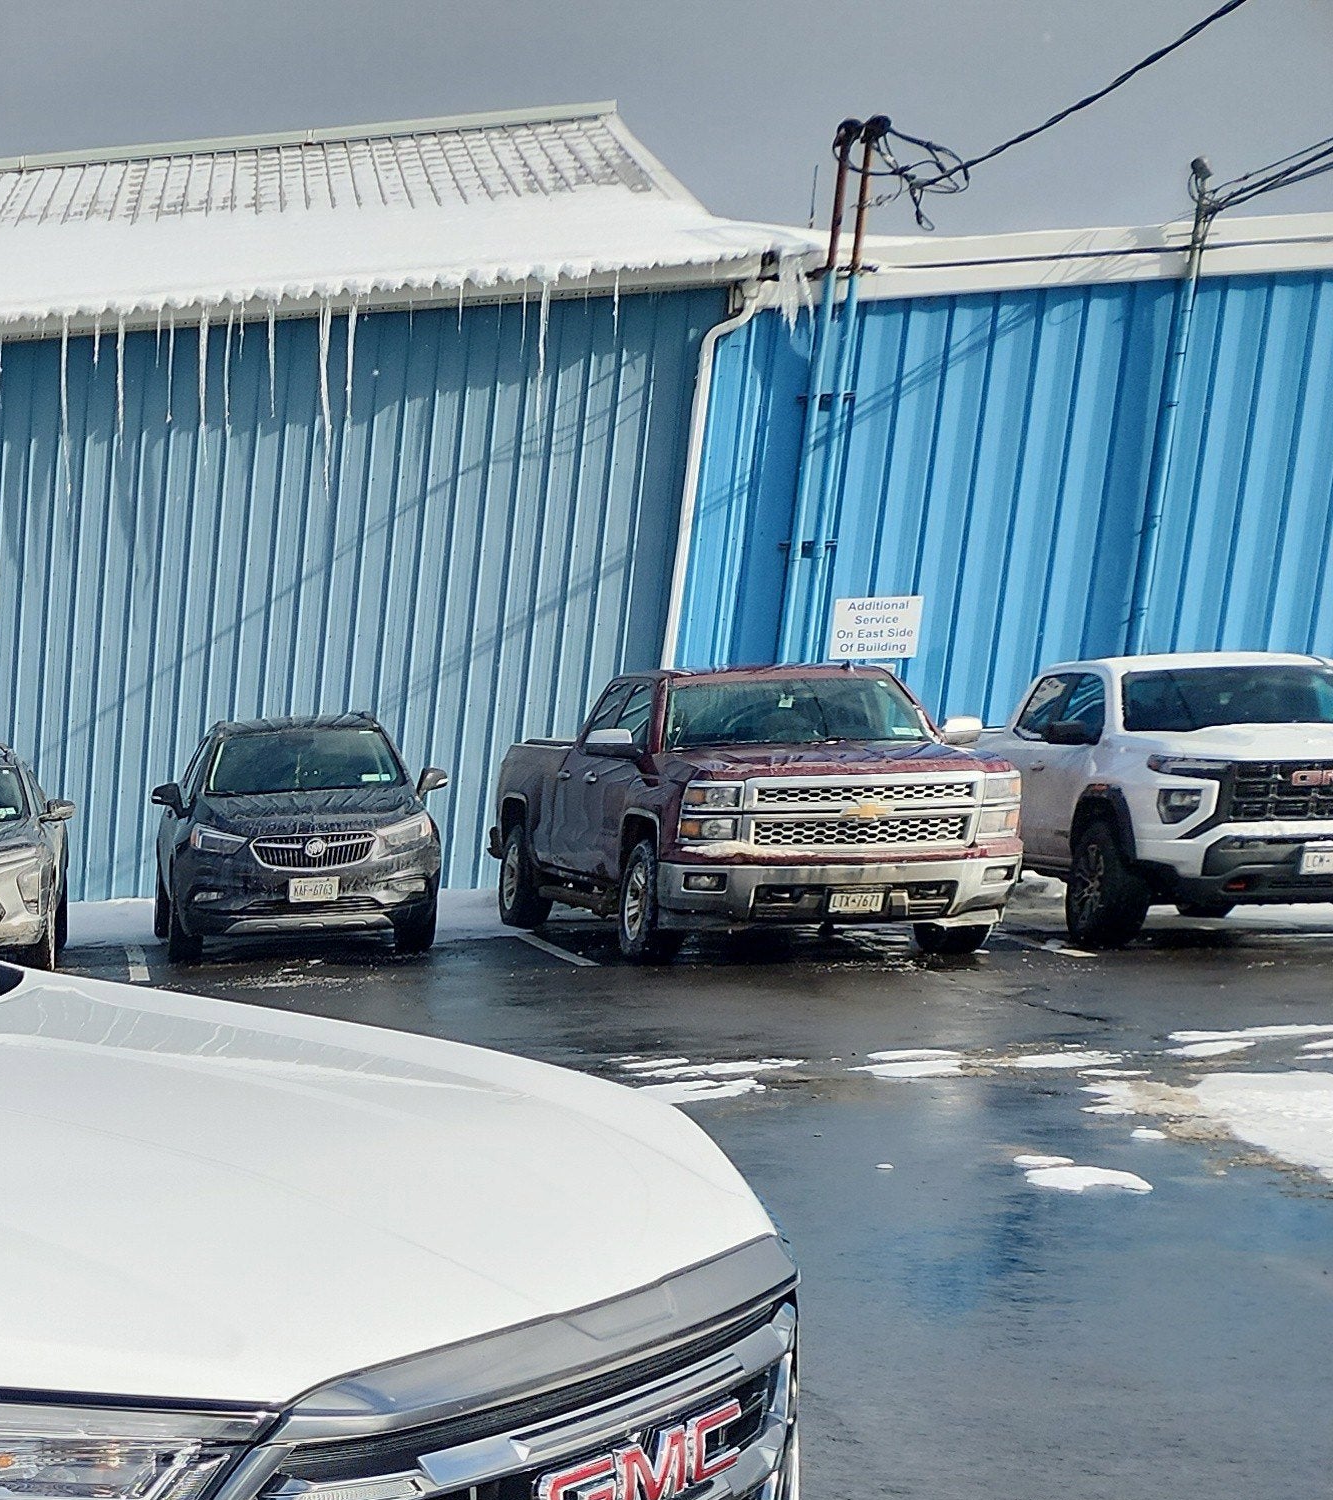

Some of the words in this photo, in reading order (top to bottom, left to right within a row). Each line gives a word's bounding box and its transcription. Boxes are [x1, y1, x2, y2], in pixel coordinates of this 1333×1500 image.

[847, 600, 910, 612] Additional
[854, 614, 900, 625] Service
[836, 629, 854, 640] On
[857, 628, 884, 639] East
[887, 627, 914, 638] Side
[839, 642, 854, 653] Of
[857, 641, 907, 654] Building
[832, 894, 881, 908] LTX-7671
